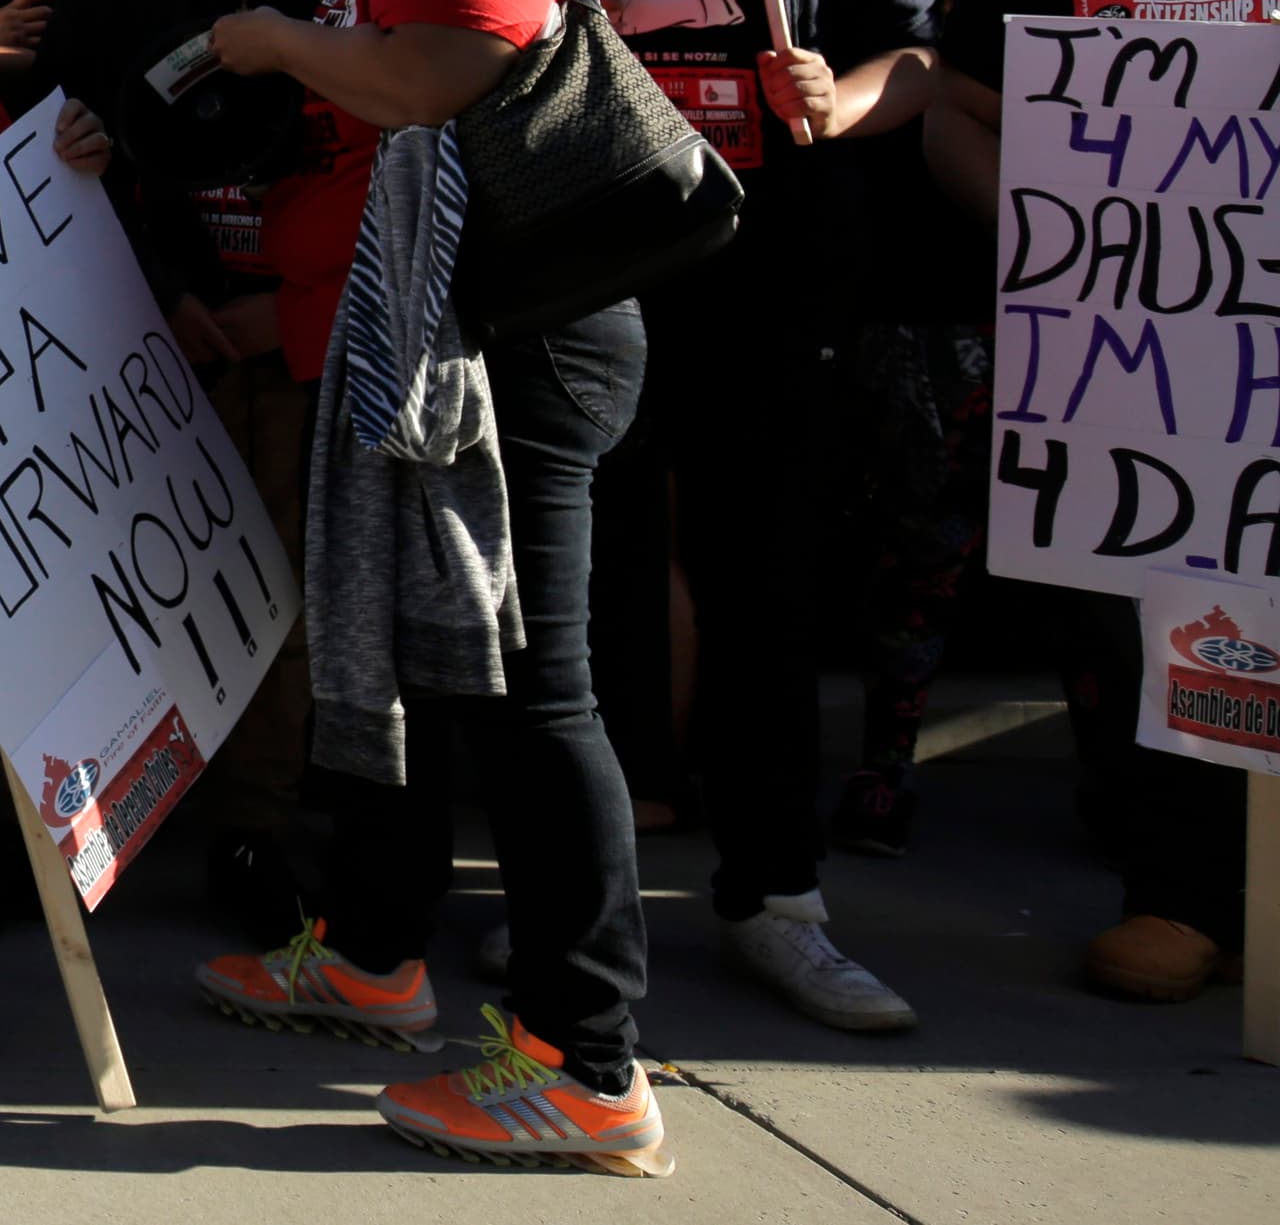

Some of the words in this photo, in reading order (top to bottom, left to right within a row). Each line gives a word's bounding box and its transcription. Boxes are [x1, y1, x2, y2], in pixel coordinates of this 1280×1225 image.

[1025, 25, 1199, 110] I'M
[1070, 111, 1133, 188] 4
[997, 428, 1069, 549] 4
[90, 437, 236, 676] NOW
[99, 686, 162, 759] GAMALIEL
[1170, 679, 1241, 731] Asamblea
[1244, 694, 1264, 734] de
[67, 824, 117, 895] Asamblea
